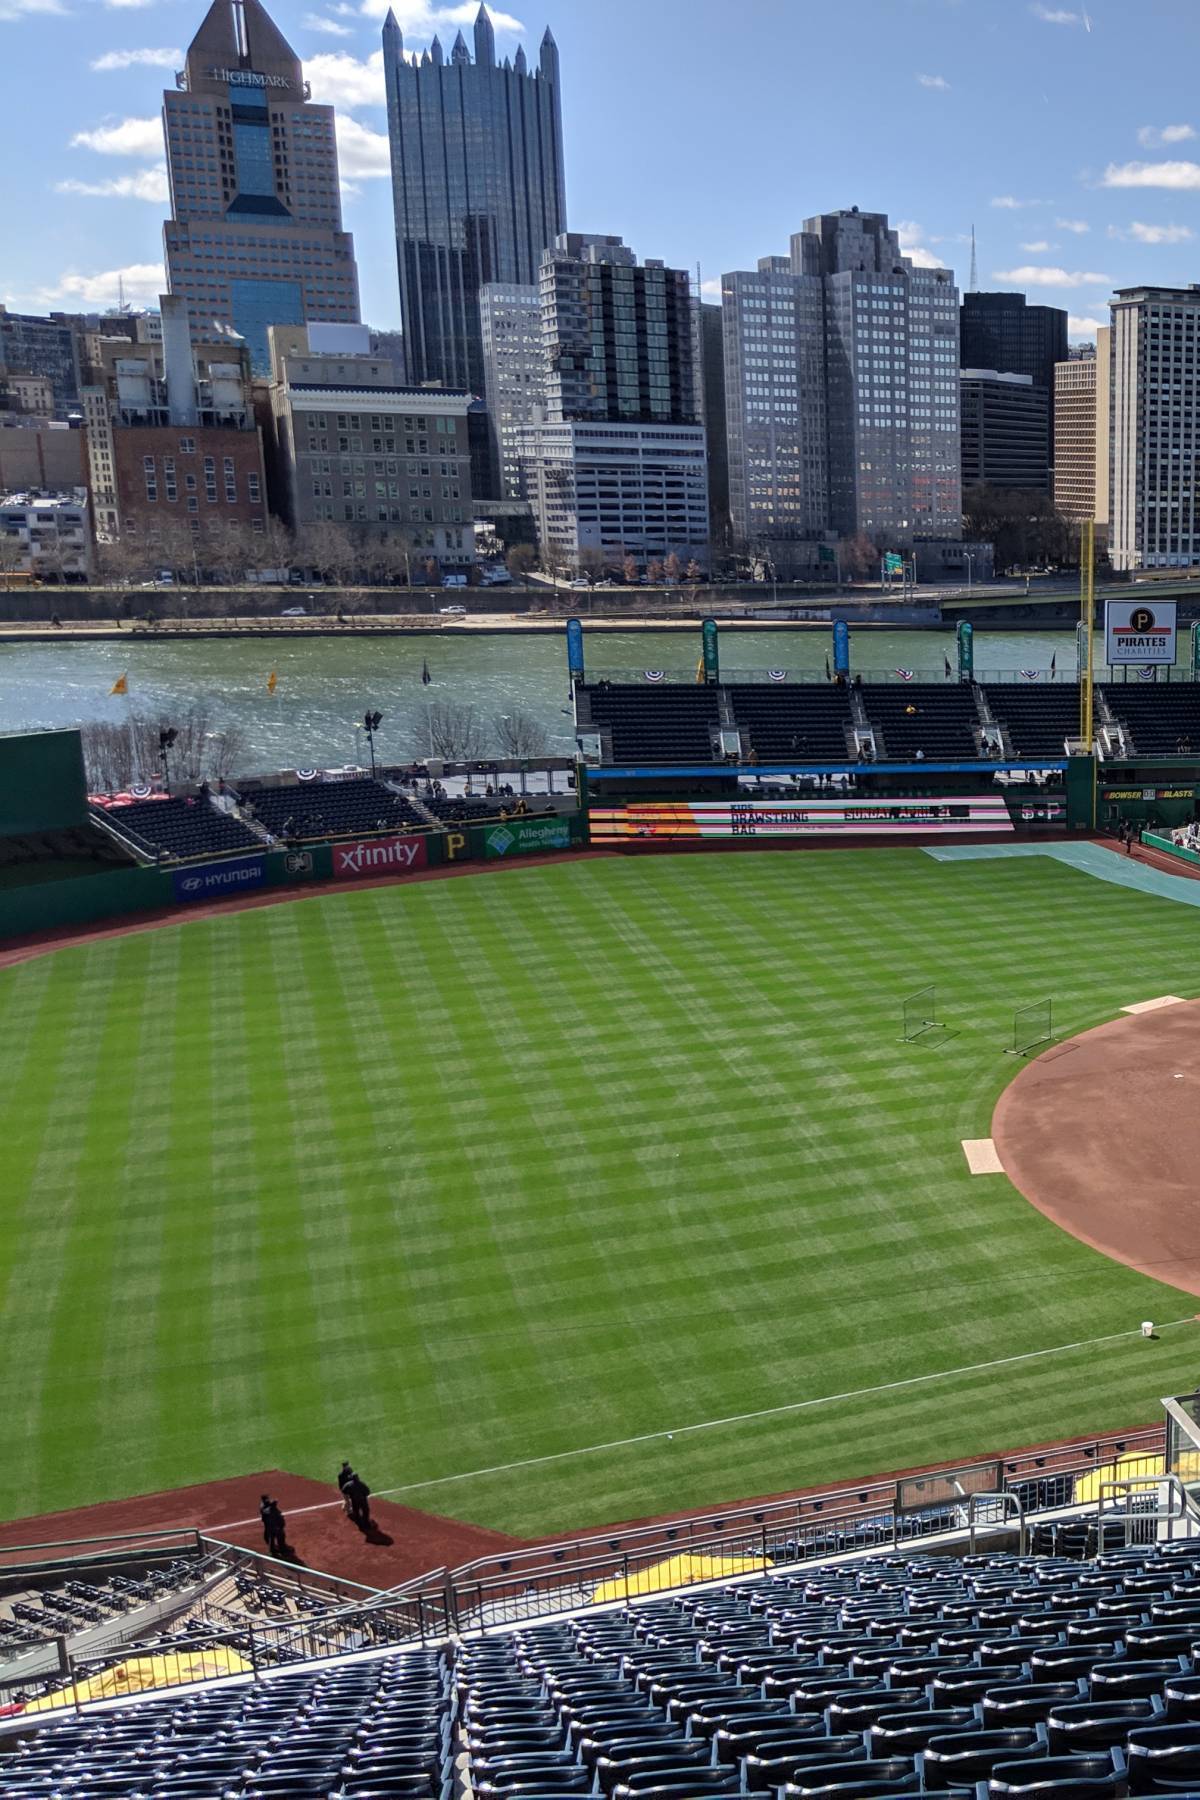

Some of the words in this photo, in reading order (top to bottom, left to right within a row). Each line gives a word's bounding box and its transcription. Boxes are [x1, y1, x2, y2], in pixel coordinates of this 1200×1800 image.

[214, 68, 289, 88] HIGHMARK
[1137, 613, 1149, 629] P
[1117, 637, 1166, 647] PIRATES
[1109, 791, 1142, 799] BOWSER
[1164, 790, 1193, 798] BLASTS
[731, 812, 809, 824] DRAWSTRING
[519, 826, 569, 839] Allegheny
[732, 825, 756, 836] BAG
[447, 834, 465, 859] P
[340, 843, 420, 872] xfinity
[206, 867, 261, 886] HYUNDAI
